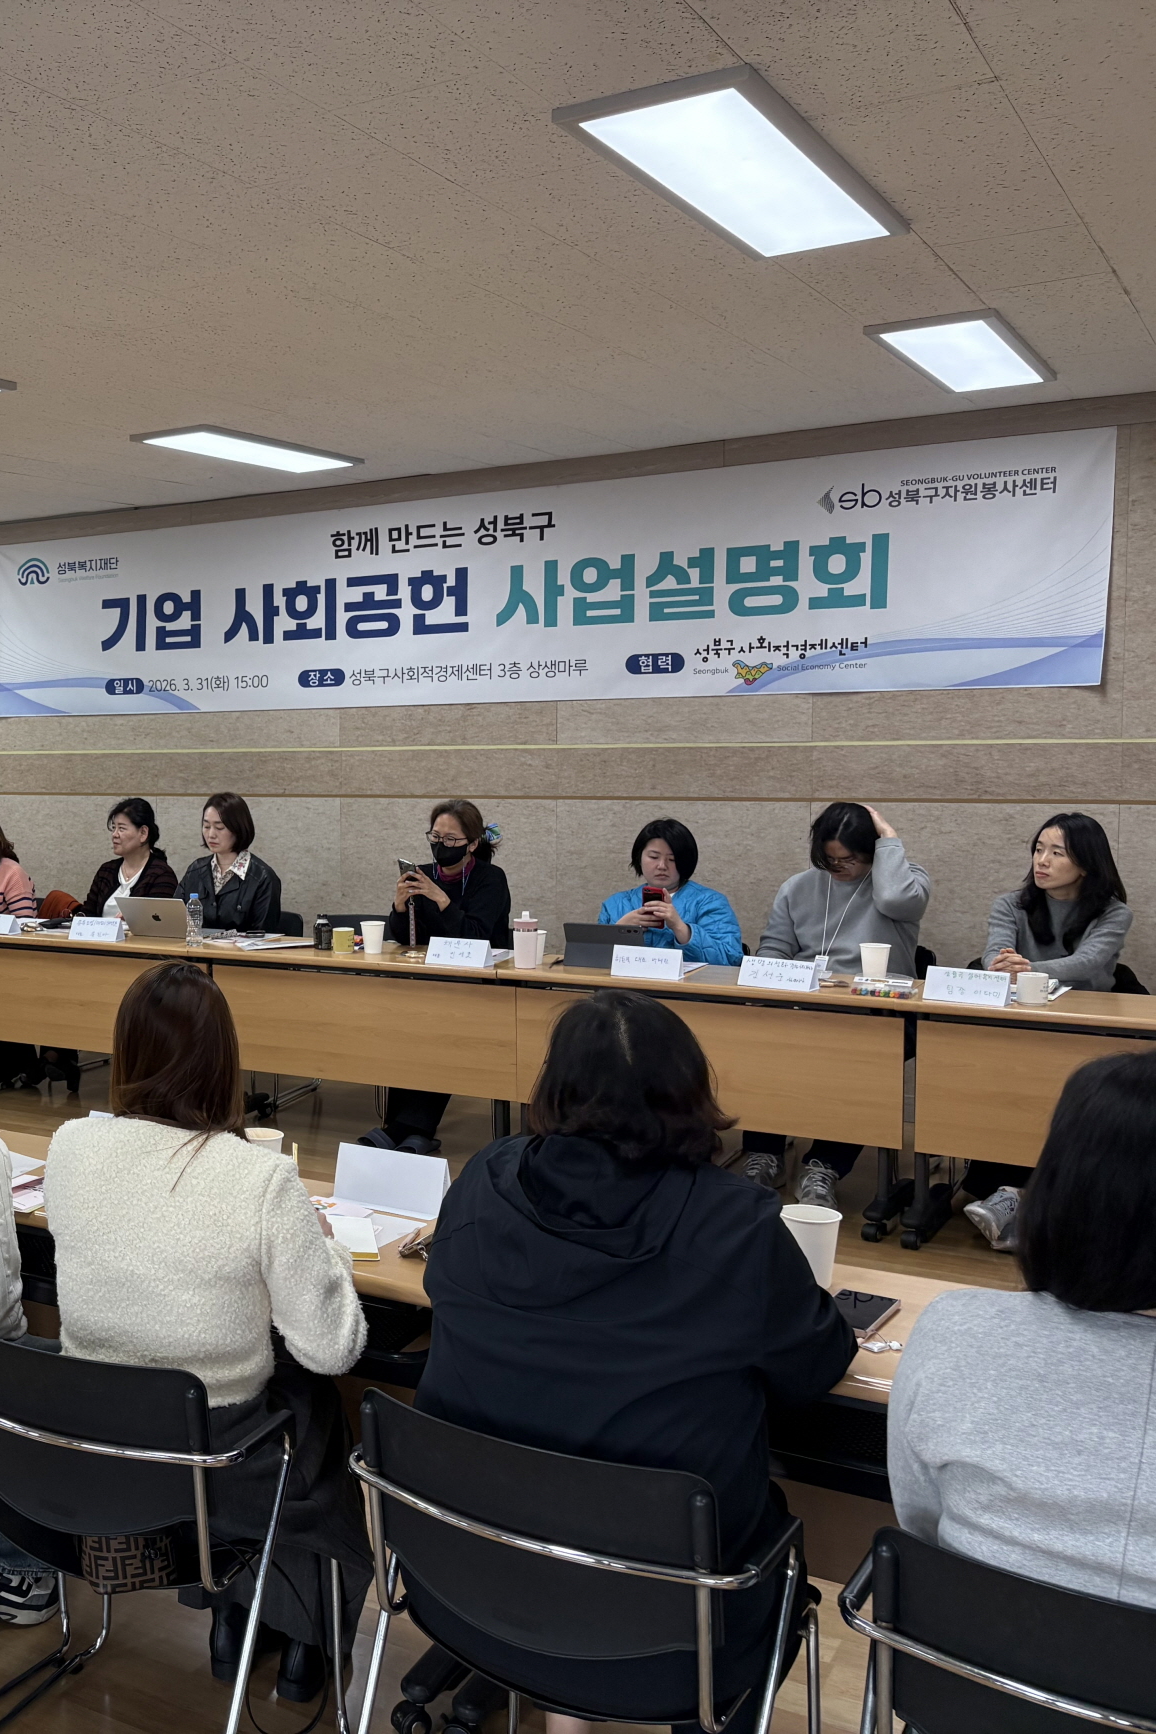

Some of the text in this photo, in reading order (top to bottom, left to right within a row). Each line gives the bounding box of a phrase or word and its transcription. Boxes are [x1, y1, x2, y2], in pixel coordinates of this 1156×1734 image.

[900, 466, 1057, 486] SEONGBUK-GU VOLUNTEER CENTER
[838, 482, 883, 511] sb
[885, 475, 1058, 508] 성북구자원봉사센터
[330, 510, 556, 560] 함께 만드는 성북구
[57, 557, 119, 575] 성북복지재단
[101, 532, 890, 652] 기업 사회공헌 사업설명회
[349, 658, 589, 686] 성북구사회적경제센터 3층 상생마루
[639, 655, 672, 672] 협력
[693, 661, 868, 675] Seongbuk Social Economy Center
[113, 679, 137, 694] 일시
[148, 674, 269, 692] 2026. 3. 31(화) 15:00
[308, 670, 336, 685] 장소
